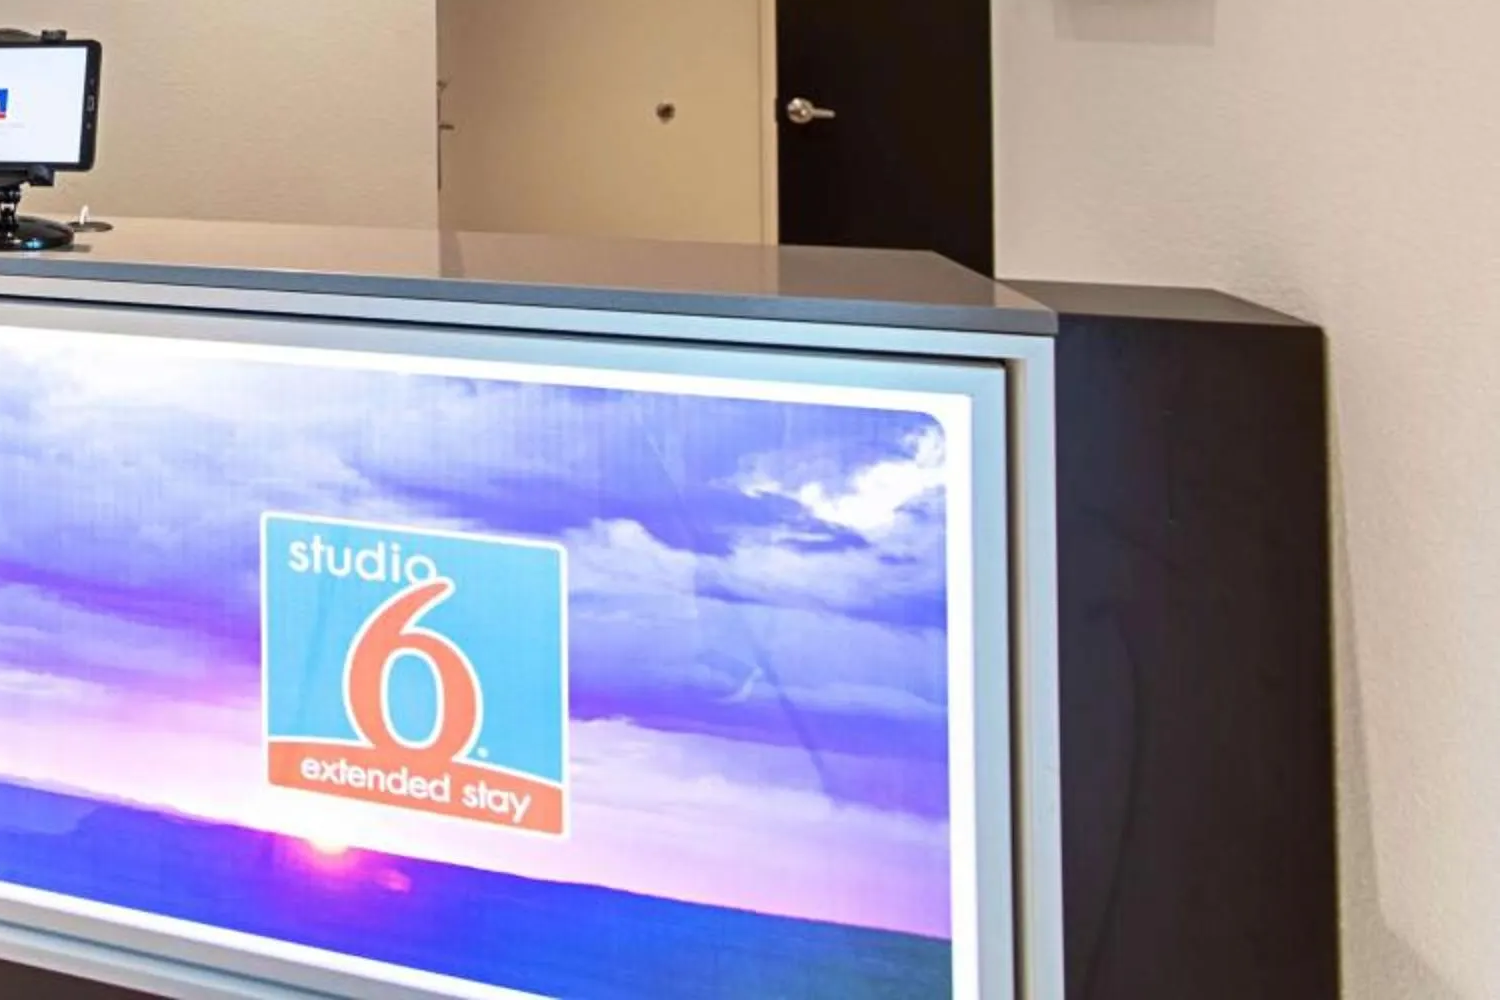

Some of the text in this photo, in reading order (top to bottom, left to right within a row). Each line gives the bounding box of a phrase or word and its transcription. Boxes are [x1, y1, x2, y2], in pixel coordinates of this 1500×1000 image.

[288, 535, 437, 586] studio
[342, 576, 483, 762] 6
[300, 756, 532, 824] extended stay
